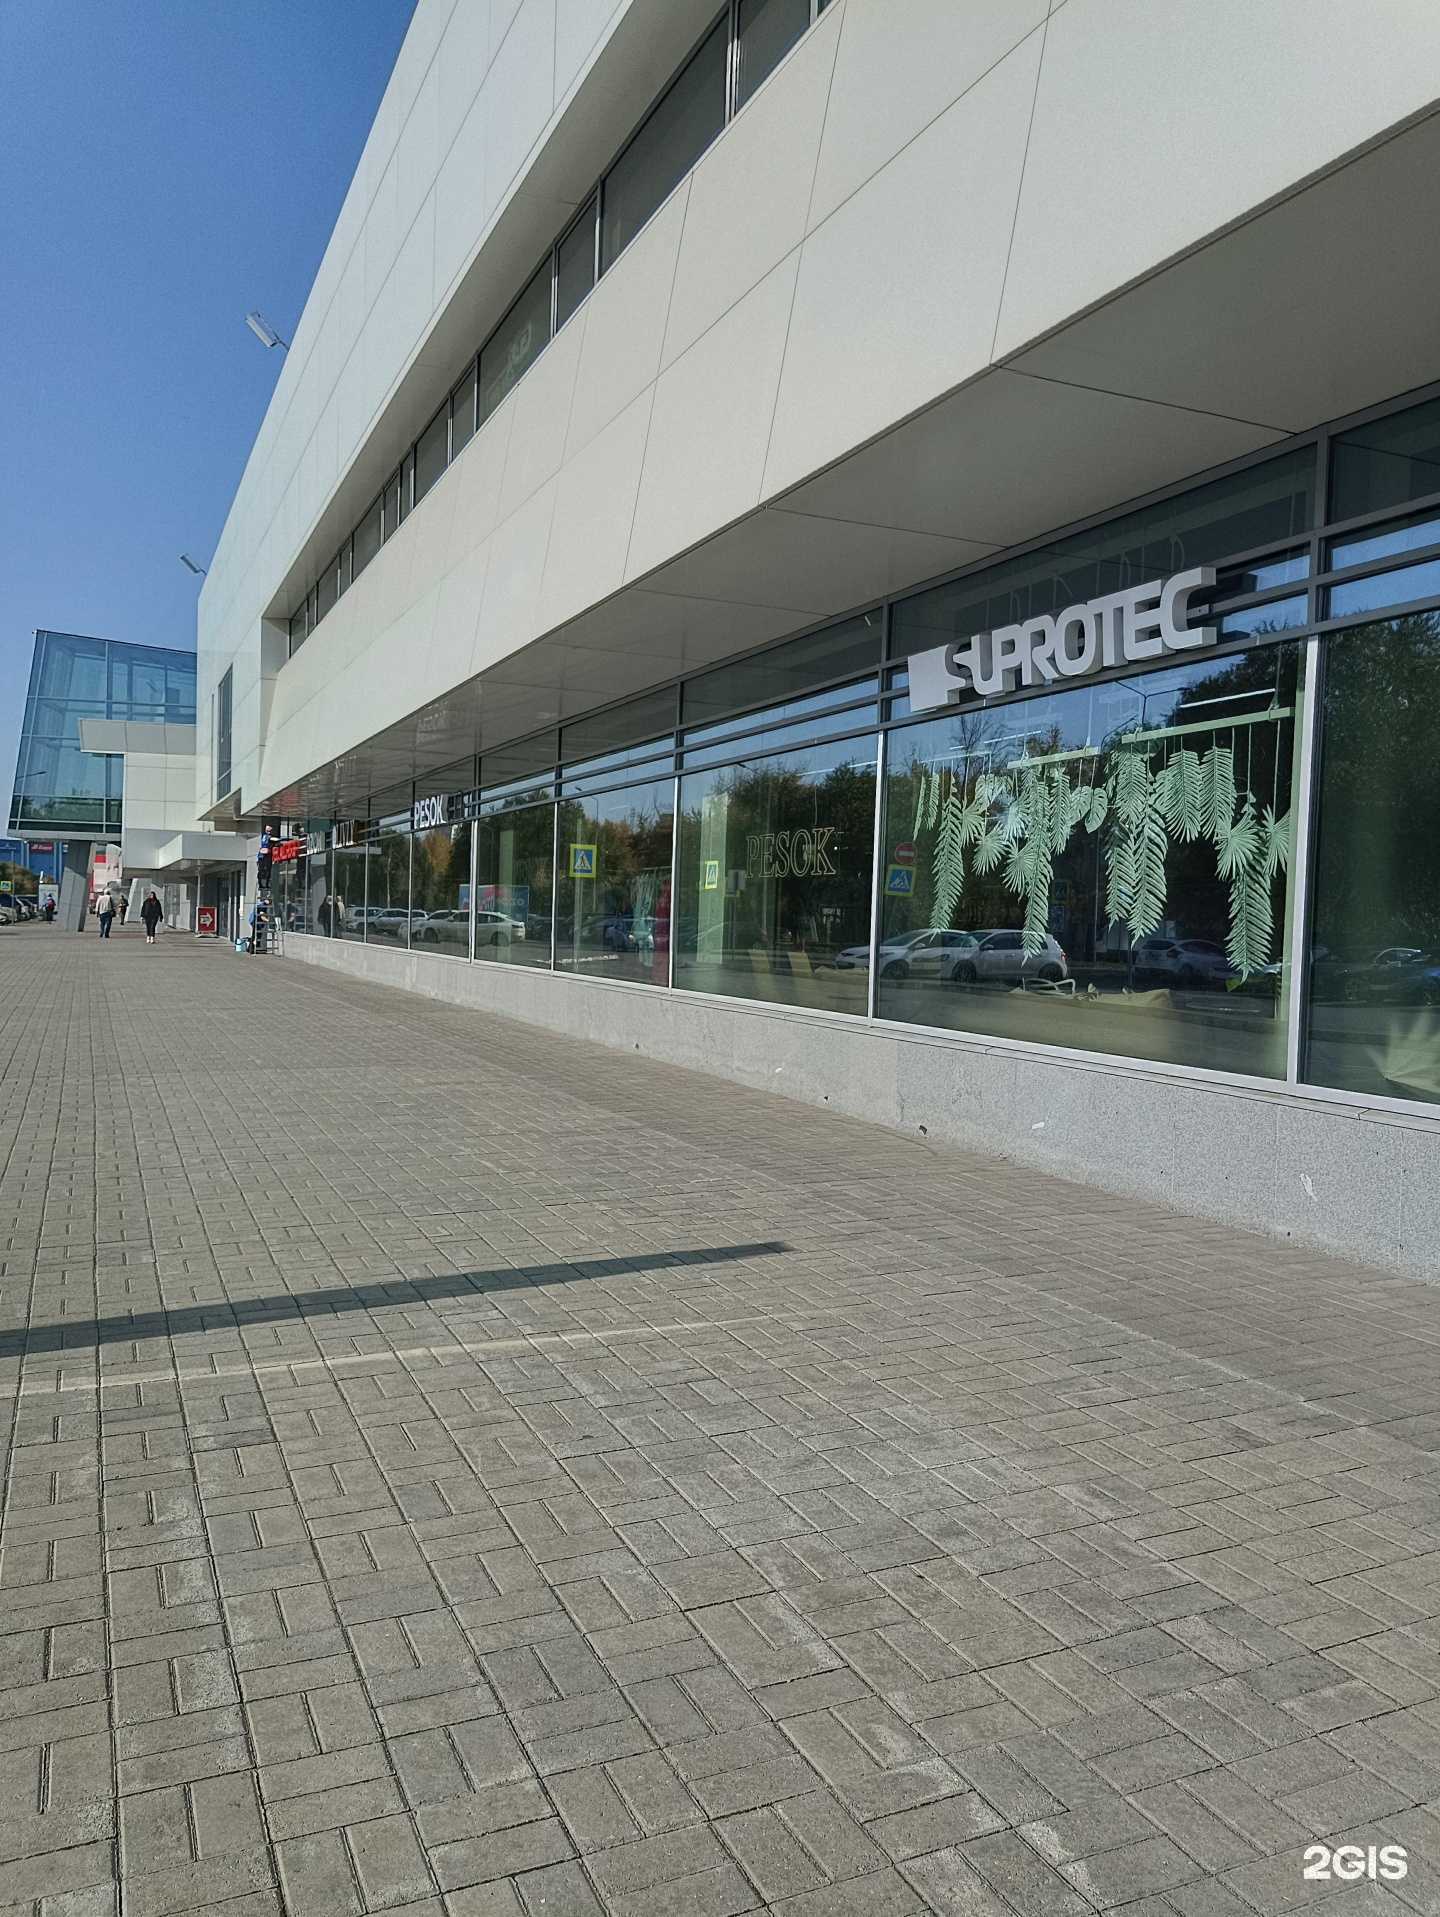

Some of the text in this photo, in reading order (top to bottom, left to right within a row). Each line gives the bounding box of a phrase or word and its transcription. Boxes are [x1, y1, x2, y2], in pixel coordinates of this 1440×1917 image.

[934, 567, 1217, 704] SUPROTEC
[414, 794, 447, 830] PESOK
[744, 826, 838, 879] PESOK
